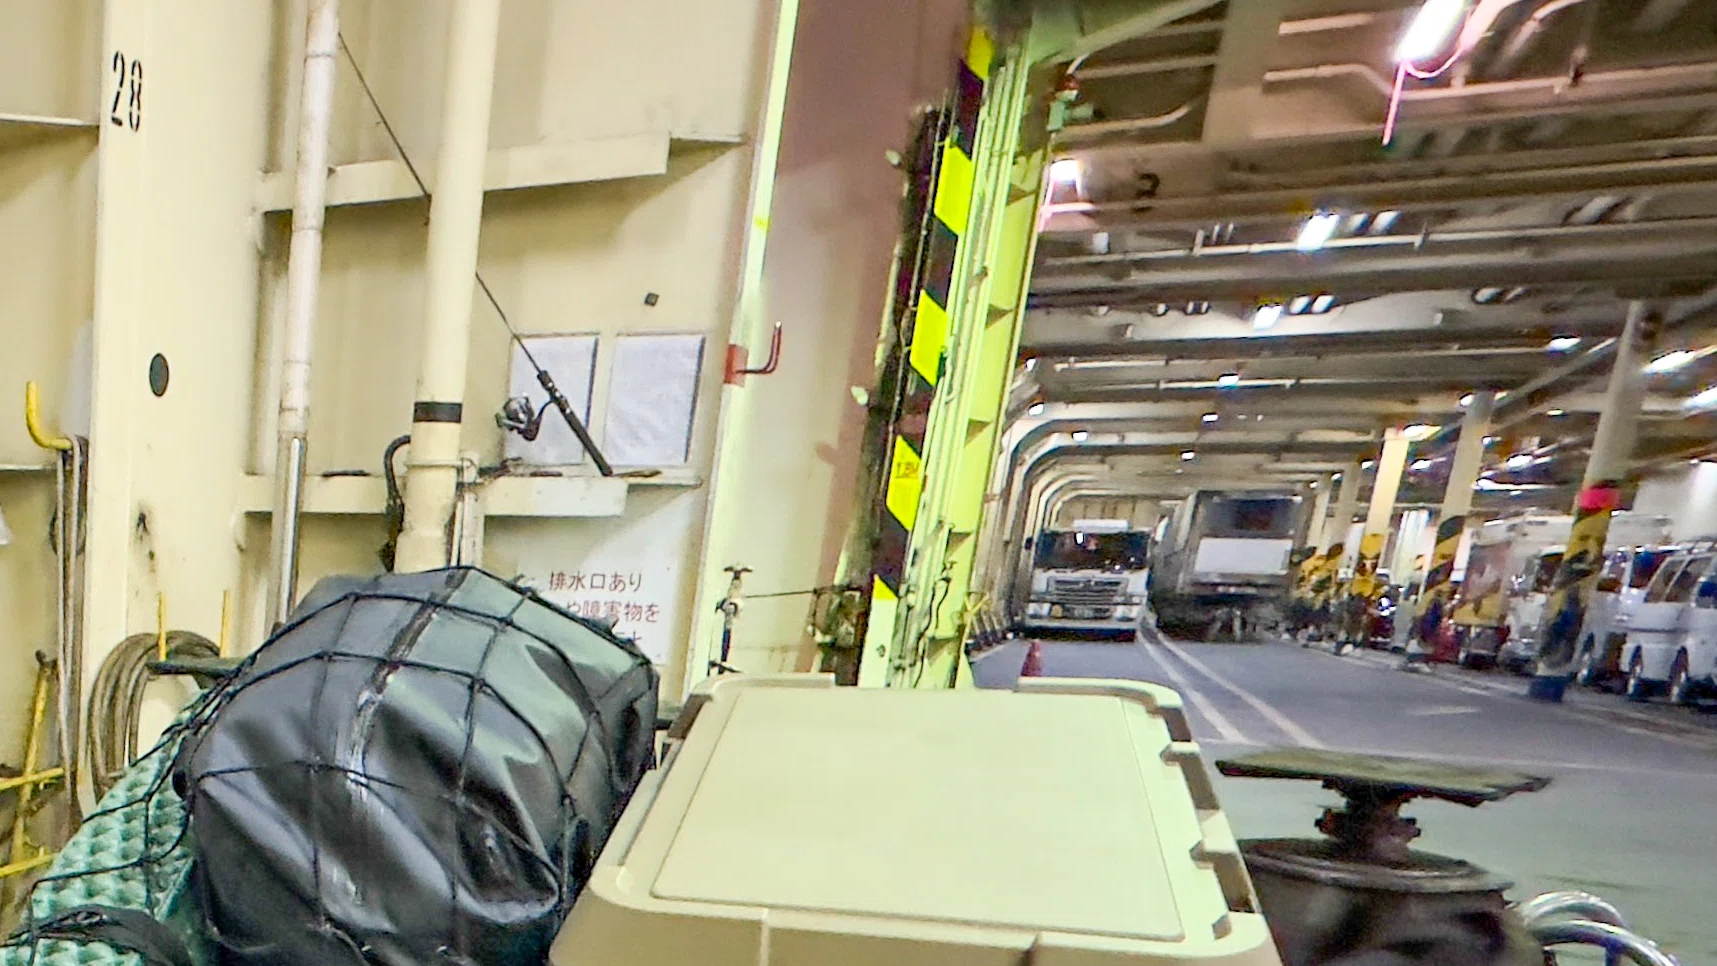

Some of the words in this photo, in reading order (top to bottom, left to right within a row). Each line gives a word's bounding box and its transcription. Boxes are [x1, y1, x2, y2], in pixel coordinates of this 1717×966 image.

[110, 51, 142, 131] 28
[548, 570, 642, 592] 排水口あり
